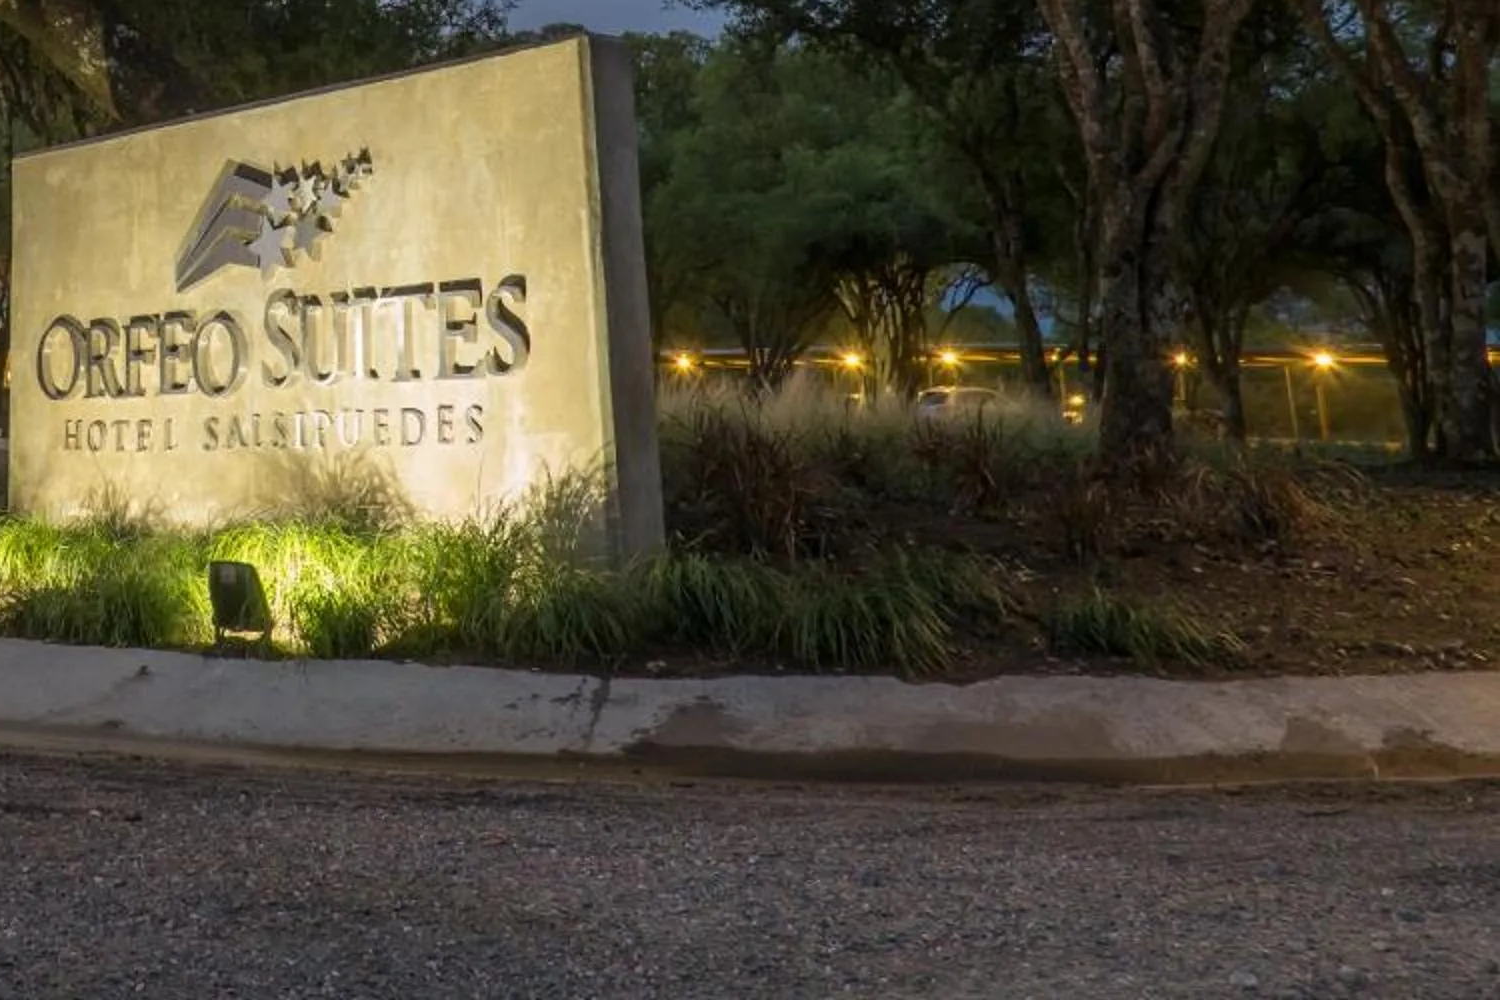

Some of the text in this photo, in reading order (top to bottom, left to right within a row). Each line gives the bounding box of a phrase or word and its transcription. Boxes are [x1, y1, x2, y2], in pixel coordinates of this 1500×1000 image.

[37, 274, 531, 400] ORFEO SUITES
[63, 404, 484, 452] HOTEL SALSIPUEDES
